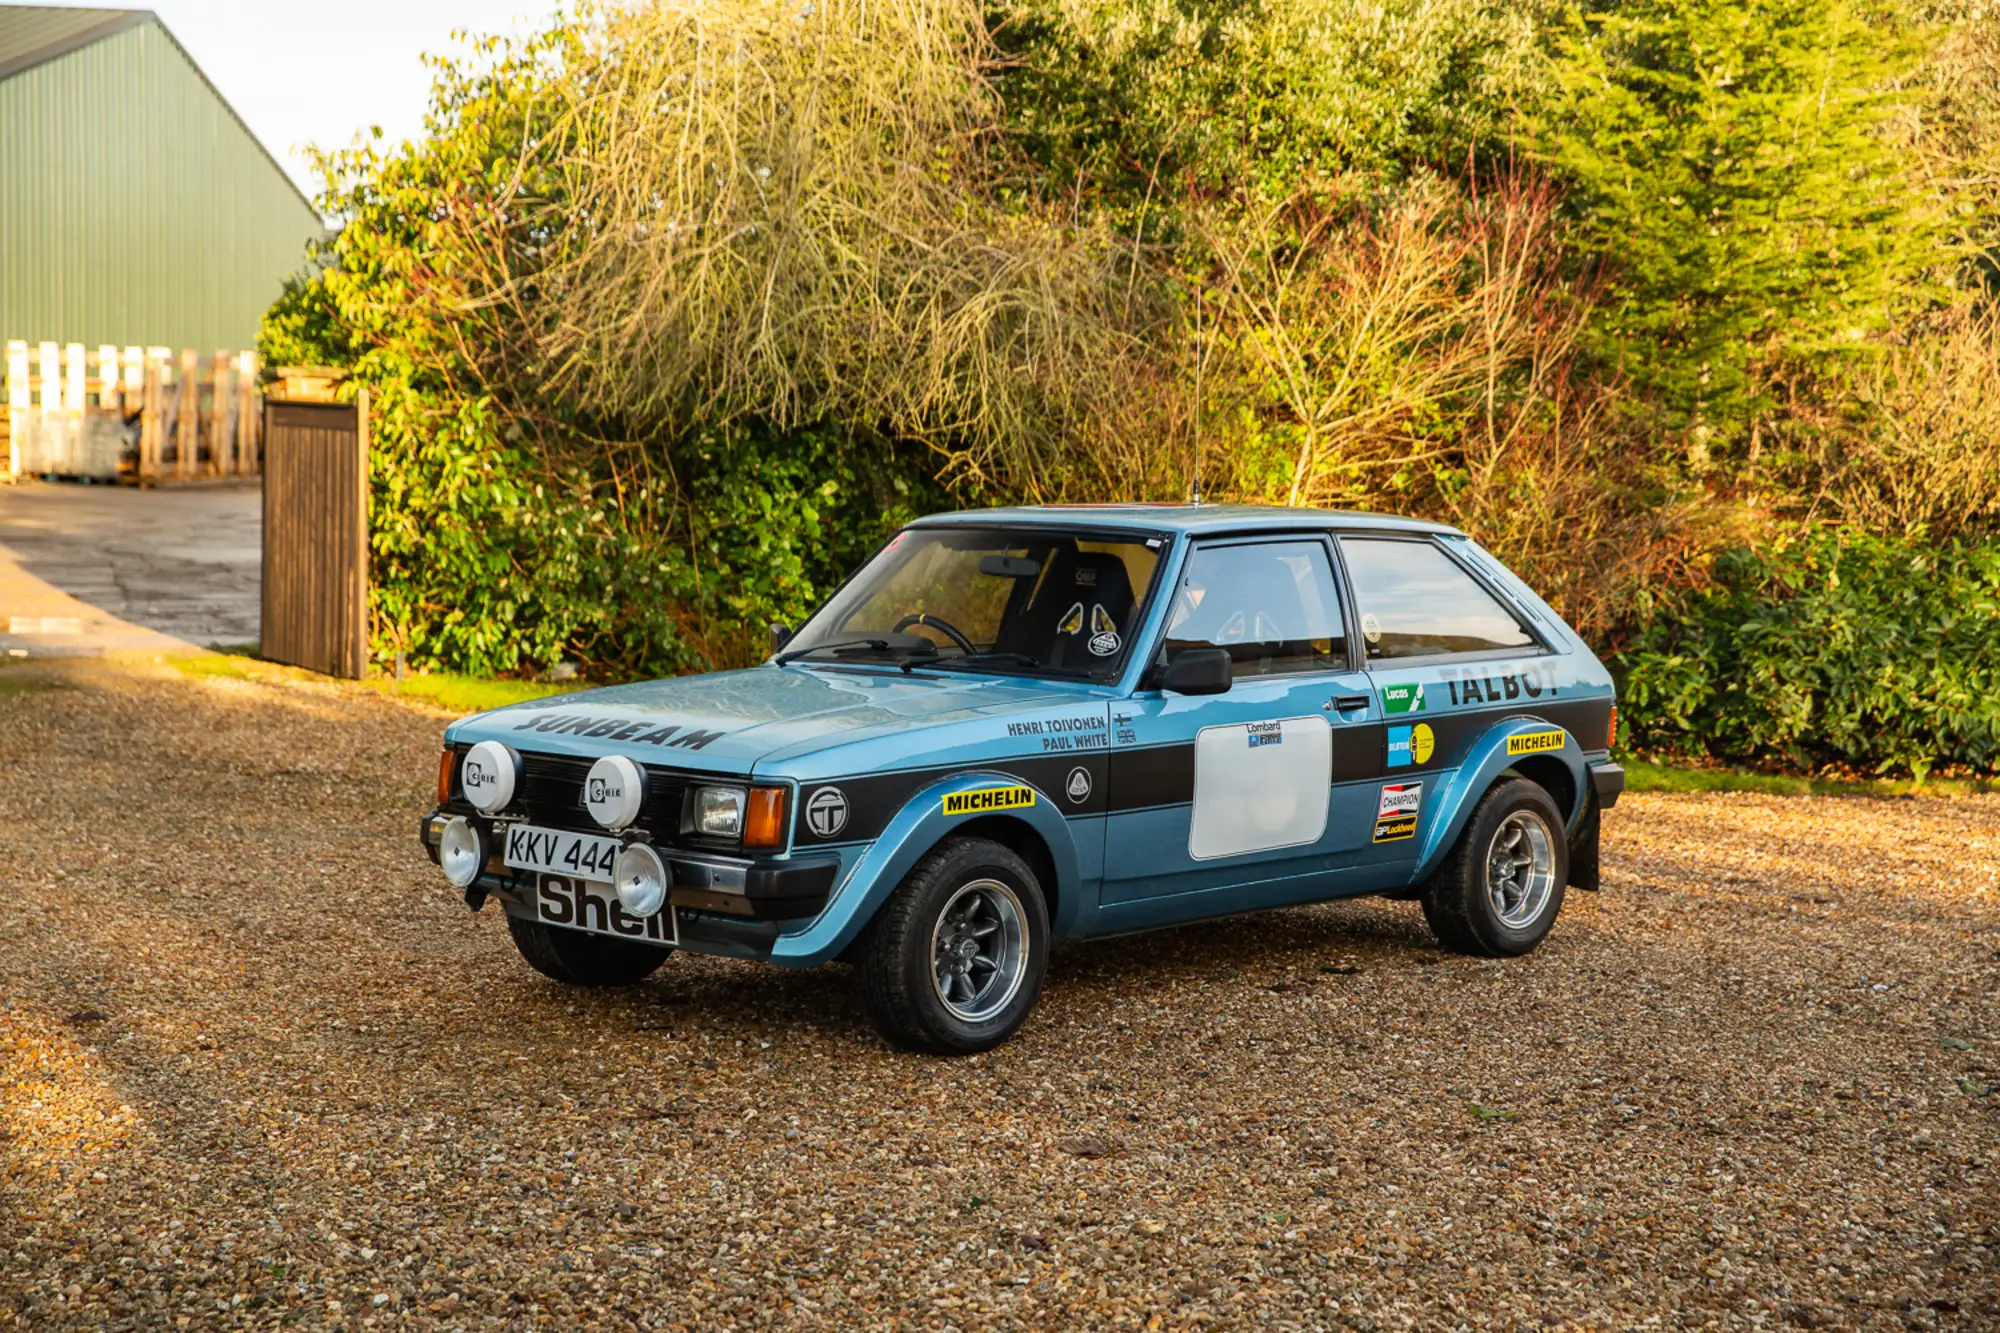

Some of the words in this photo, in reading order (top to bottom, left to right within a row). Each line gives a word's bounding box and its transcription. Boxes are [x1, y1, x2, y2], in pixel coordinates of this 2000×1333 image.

[1384, 686, 1409, 700] Lucas
[1438, 660, 1558, 706] TALBOT
[513, 714, 727, 751] SUNBEAM
[1007, 721, 1044, 737] HENRI
[1045, 716, 1106, 733] TOIVONEN
[1246, 719, 1281, 734] Lombard
[1042, 737, 1073, 751] PAUL
[1073, 733, 1108, 749] WHITE
[1510, 732, 1563, 752] MICHELIN
[947, 788, 1032, 812] MICHELIN
[1383, 793, 1418, 809] CHAMPION
[508, 828, 559, 866] KKV
[564, 839, 617, 877] 444
